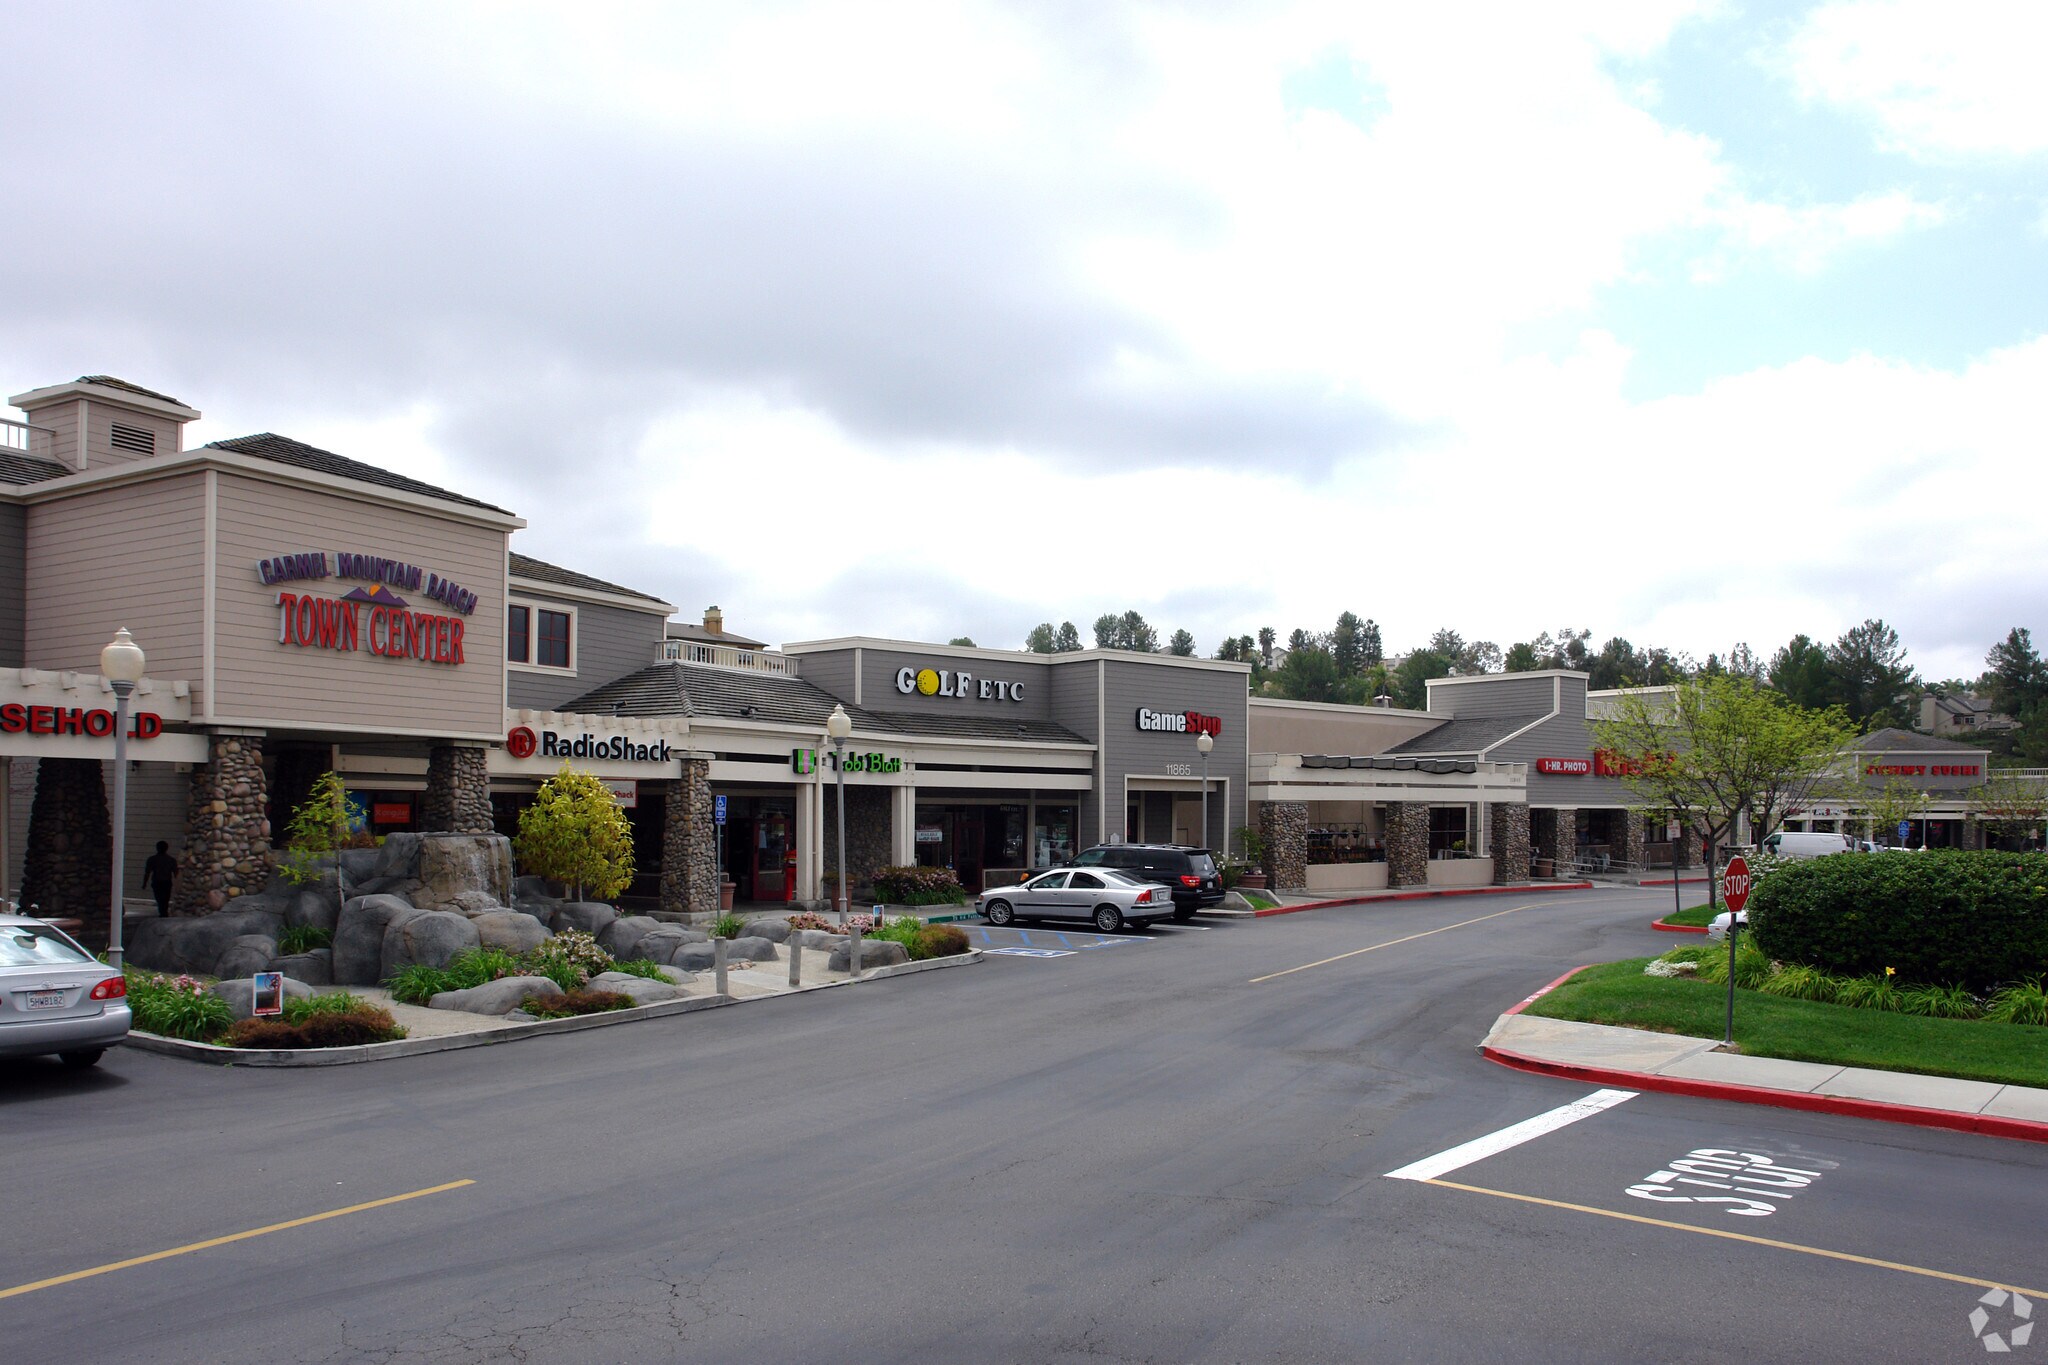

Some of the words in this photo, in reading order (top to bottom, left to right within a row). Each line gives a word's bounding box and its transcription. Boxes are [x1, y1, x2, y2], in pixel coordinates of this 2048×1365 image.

[257, 552, 331, 584] CARMEL
[334, 552, 422, 590] MOUNTAIN
[424, 573, 478, 615] RANCH
[275, 592, 360, 651] TOWN
[366, 605, 465, 664] CENTER
[897, 667, 972, 697] GOLF
[979, 679, 1025, 701] ETC
[0, 703, 163, 738] SEHOD
[1137, 708, 1222, 737] GameStop
[541, 730, 671, 762] RadioShack
[1165, 764, 1190, 775] 11865
[1545, 760, 1563, 771] 1-HR.
[1563, 761, 1587, 772] PHOTO
[1931, 764, 1980, 776] SUSHI
[1725, 874, 1749, 896] STOP
[1625, 1148, 1822, 1217] STOP
